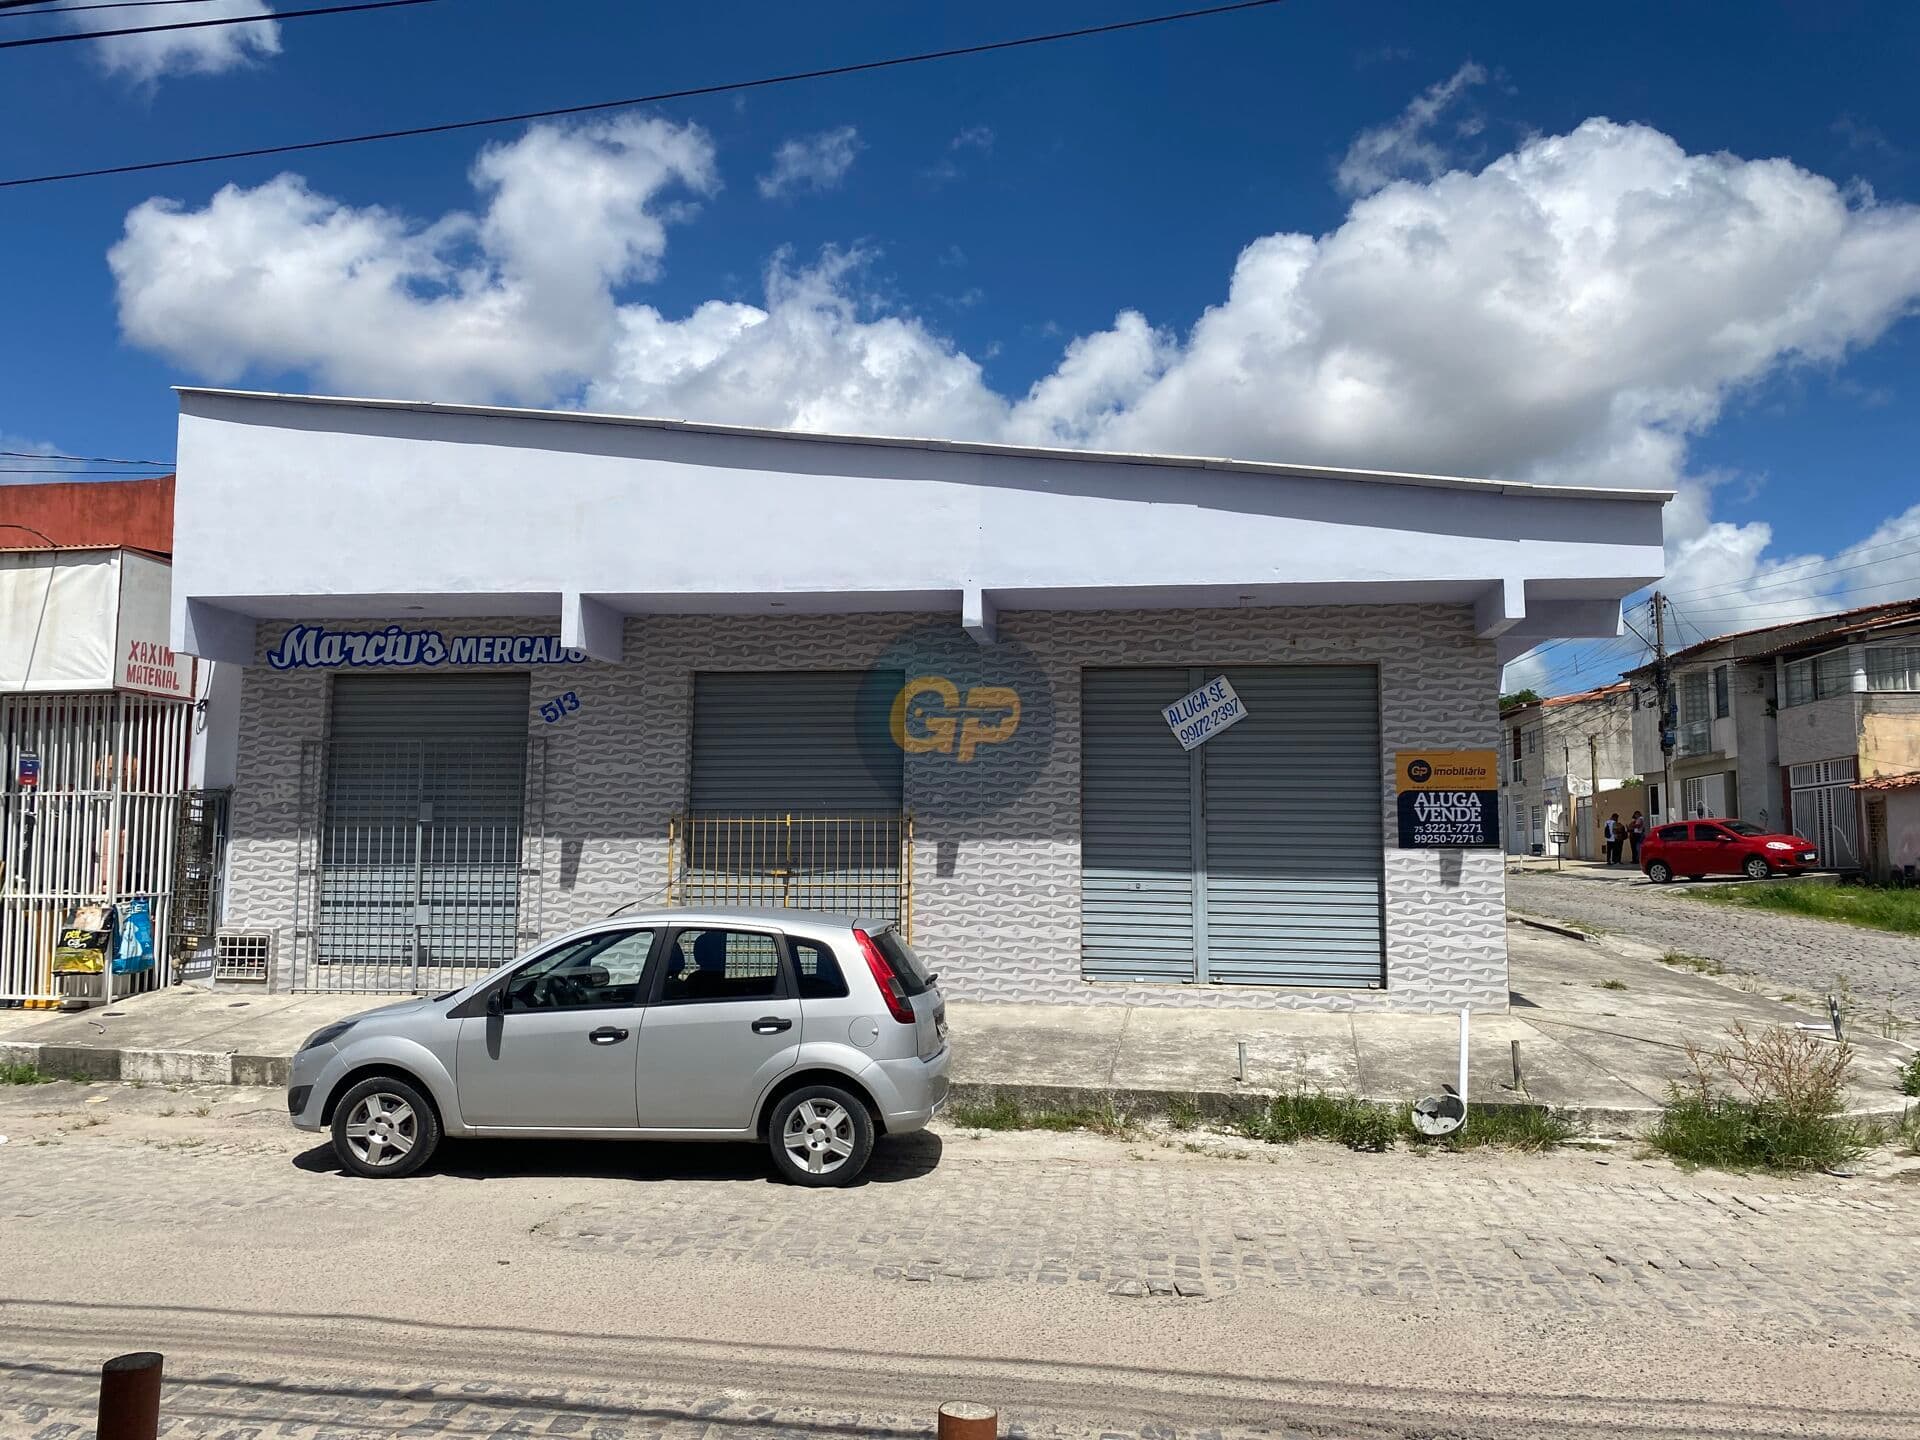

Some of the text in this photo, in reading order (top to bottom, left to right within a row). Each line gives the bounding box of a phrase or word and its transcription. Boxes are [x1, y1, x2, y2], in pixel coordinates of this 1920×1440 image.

[128, 640, 175, 668] XAXIM
[127, 663, 180, 690] MATERIAL
[540, 691, 581, 723] 513
[1180, 697, 1239, 744] 99172-2397
[1411, 766, 1428, 776] GP
[1414, 792, 1482, 807] ALUGA
[1414, 807, 1481, 822] VENDE
[1425, 823, 1482, 833] 3221-7271
[1414, 834, 1475, 844] 99250-7271
